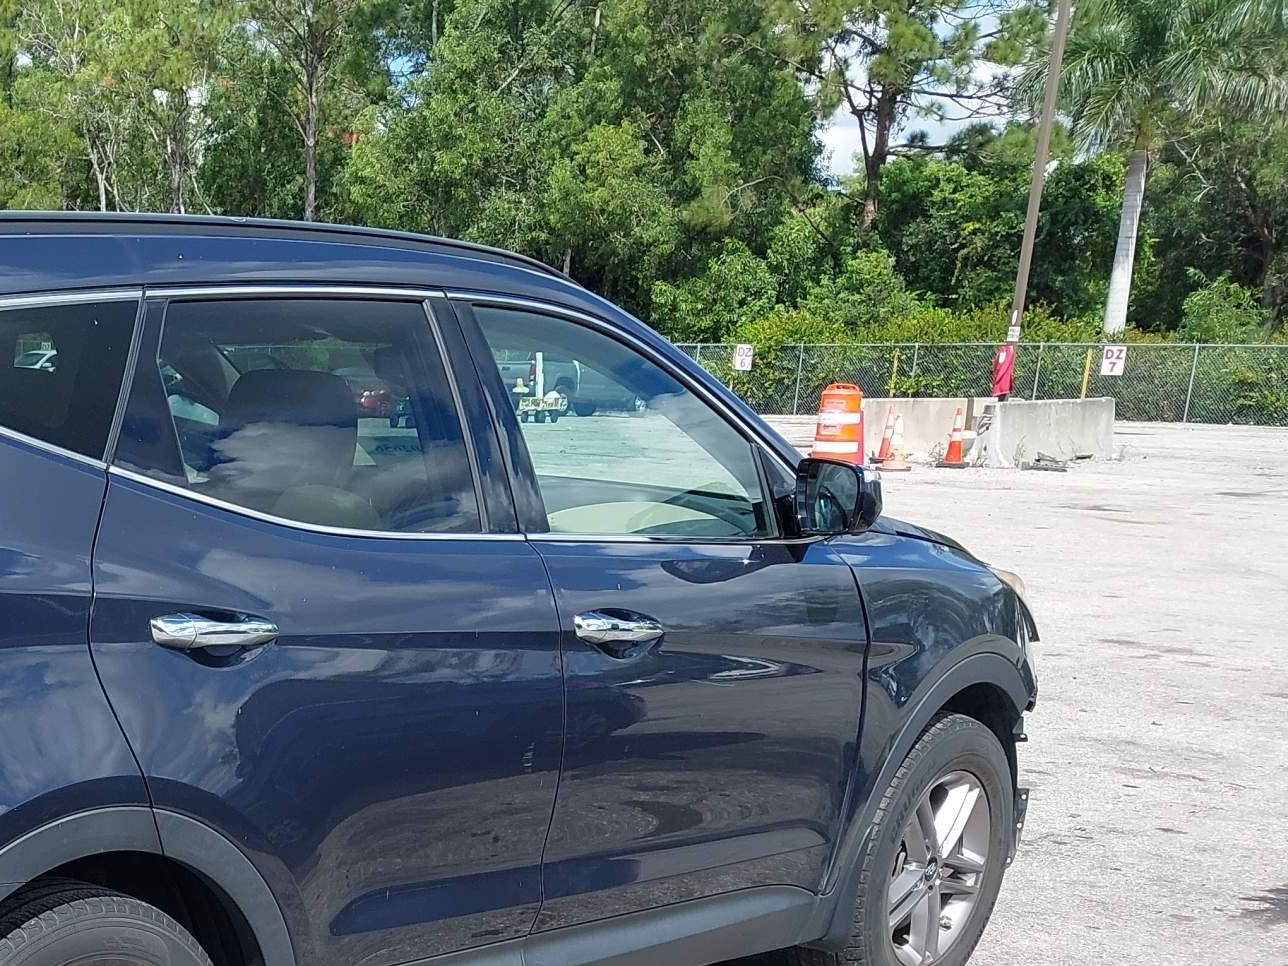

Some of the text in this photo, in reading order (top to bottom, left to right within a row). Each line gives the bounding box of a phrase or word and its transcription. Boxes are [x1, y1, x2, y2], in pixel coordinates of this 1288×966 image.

[738, 347, 752, 357] DZ
[1105, 348, 1124, 360] DZ
[1109, 361, 1117, 373] 7
